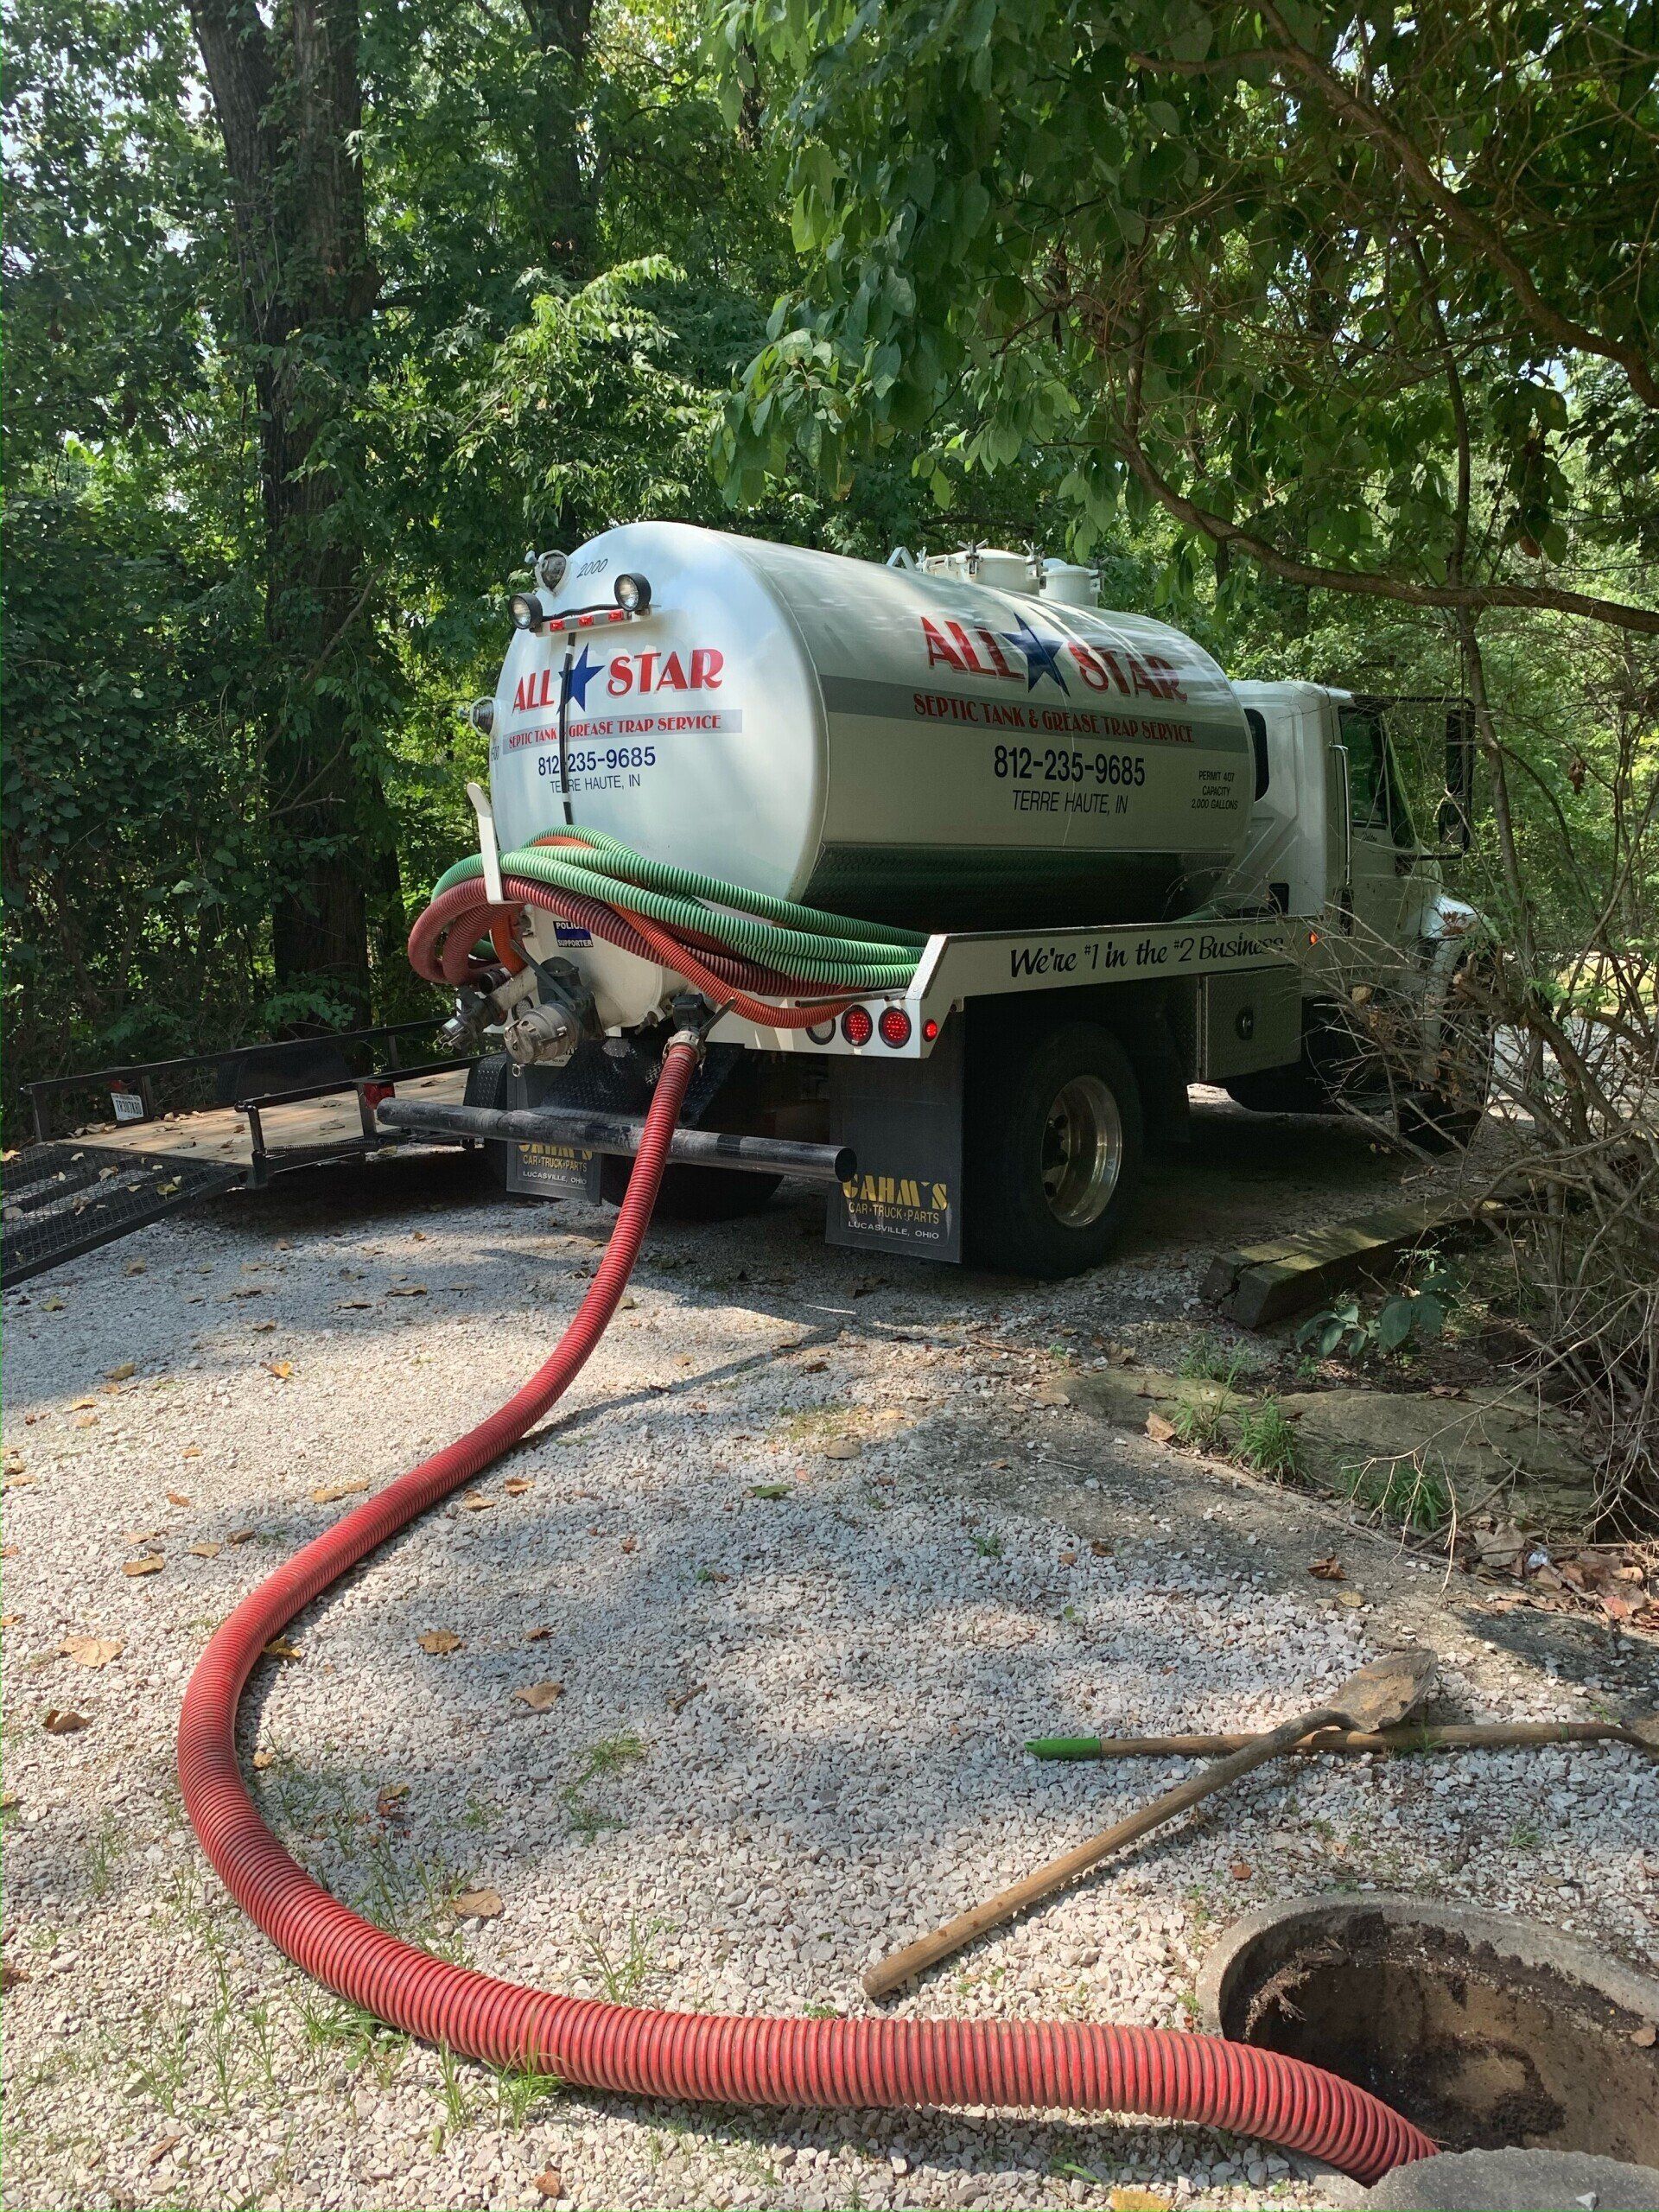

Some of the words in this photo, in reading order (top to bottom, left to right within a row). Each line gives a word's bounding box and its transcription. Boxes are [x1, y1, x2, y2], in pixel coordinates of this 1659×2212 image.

[576, 558, 608, 578] 2000
[920, 615, 1026, 681] ALL
[1068, 641, 1189, 704] STAR
[512, 669, 555, 715] ALL
[607, 648, 725, 697] STAR
[914, 693, 979, 721] SEPTIC
[980, 702, 1025, 728] TANK
[1028, 709, 1039, 728] &
[1042, 710, 1099, 734] GREASE
[1102, 716, 1139, 737] TRAP
[1141, 721, 1195, 743] SERVICE
[509, 730, 532, 749] SEPTIC
[534, 728, 557, 742] TANK
[569, 720, 613, 738] GREASE
[617, 718, 654, 734] TRAP
[658, 715, 721, 731] SERVICE
[538, 747, 657, 776] 812235-9685
[994, 745, 1146, 786] 812-235-9685
[550, 779, 581, 793] TERE
[585, 775, 625, 791] HAUTE,
[629, 774, 641, 787] IN
[1198, 770, 1221, 781] PERMIT
[1012, 789, 1059, 812] TERRE
[1065, 792, 1110, 816] HAUTE,
[1115, 794, 1128, 814] IN
[1202, 785, 1230, 797] CAPACITY
[1191, 798, 1210, 810] 2,000
[1211, 798, 1238, 810] GALLONS
[556, 921, 585, 930] POLIC
[1010, 948, 1077, 978] We're
[1104, 941, 1128, 969] in
[1135, 939, 1168, 966] the
[1173, 938, 1195, 963] #2
[523, 1171, 567, 1183] LUCASVILLE,
[848, 1220, 910, 1236] LUCASVILLE,
[914, 1230, 939, 1239] OHIO
